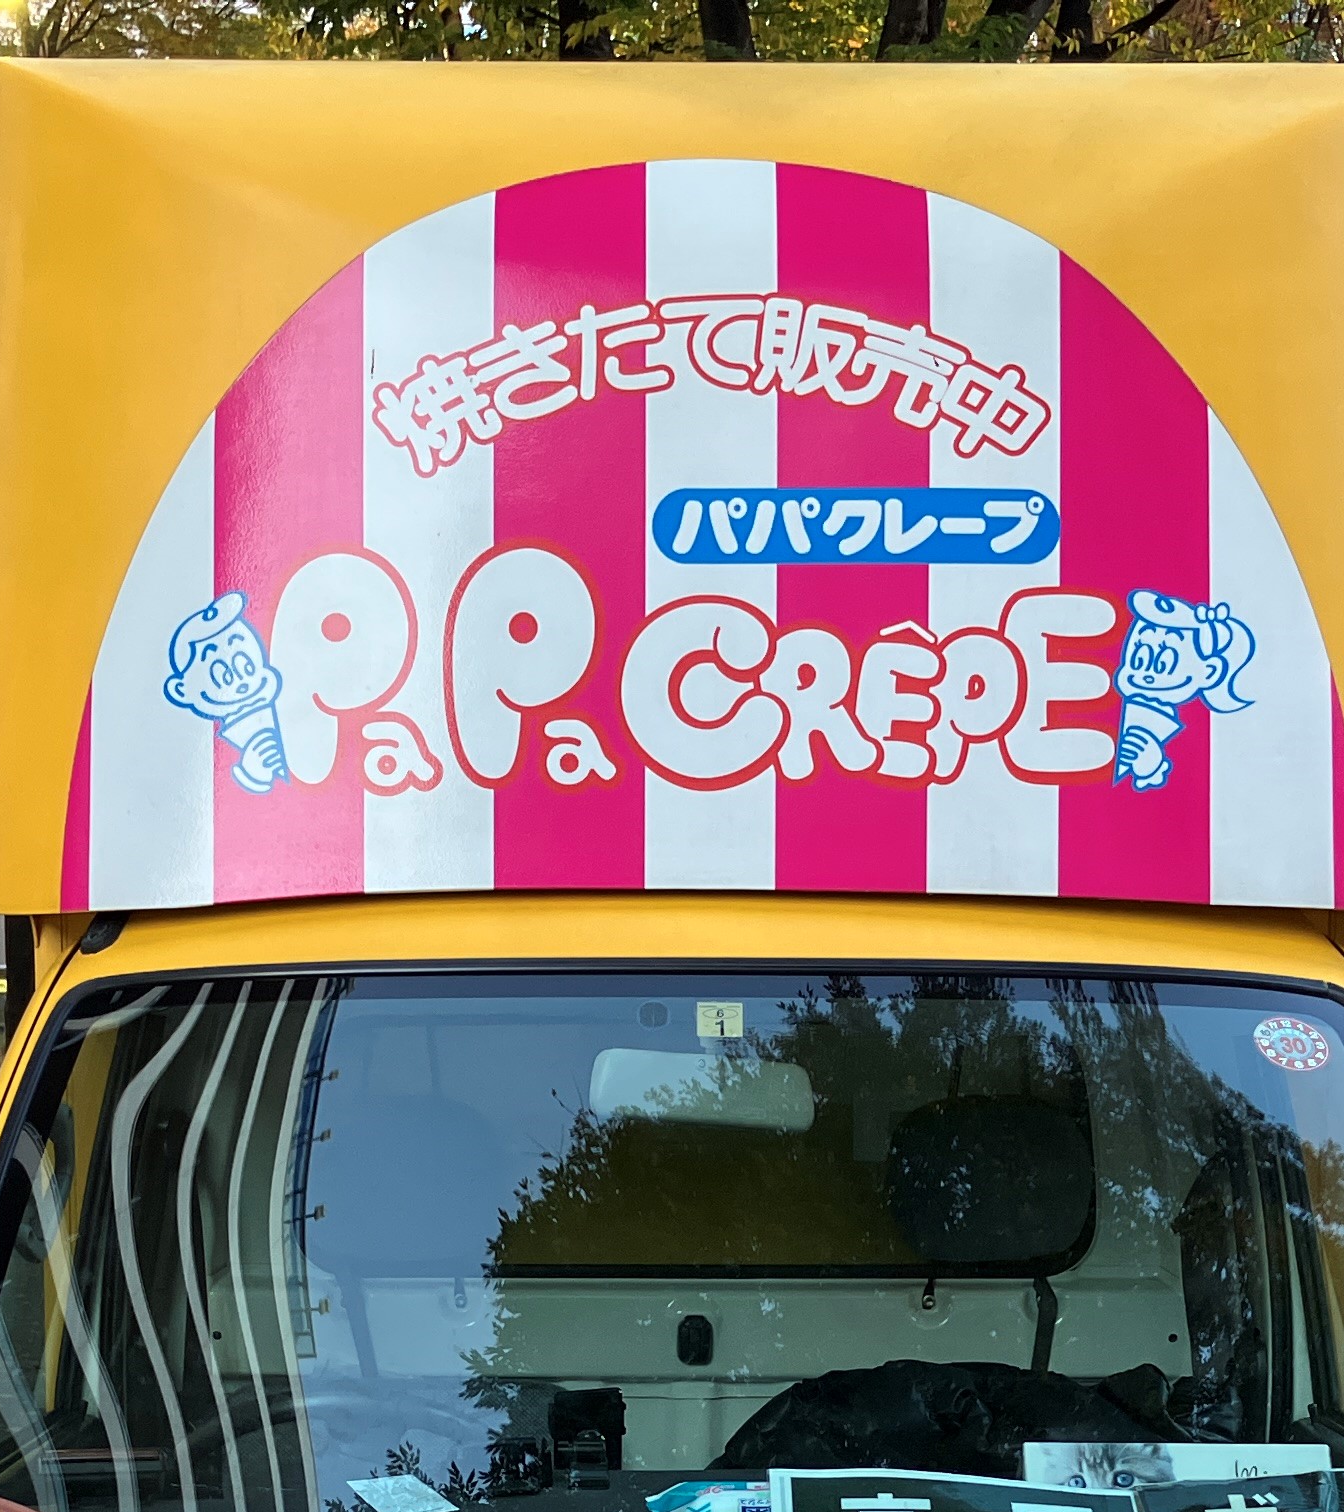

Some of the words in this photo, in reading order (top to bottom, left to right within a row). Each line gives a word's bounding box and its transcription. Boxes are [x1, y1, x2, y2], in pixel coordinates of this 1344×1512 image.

[372, 290, 1052, 478] 焼きたて販売中
[673, 494, 1046, 556] パパクレープ
[622, 588, 1120, 790] CRÊPE
[715, 1020, 725, 1036] 1
[1280, 1036, 1307, 1054] 30
